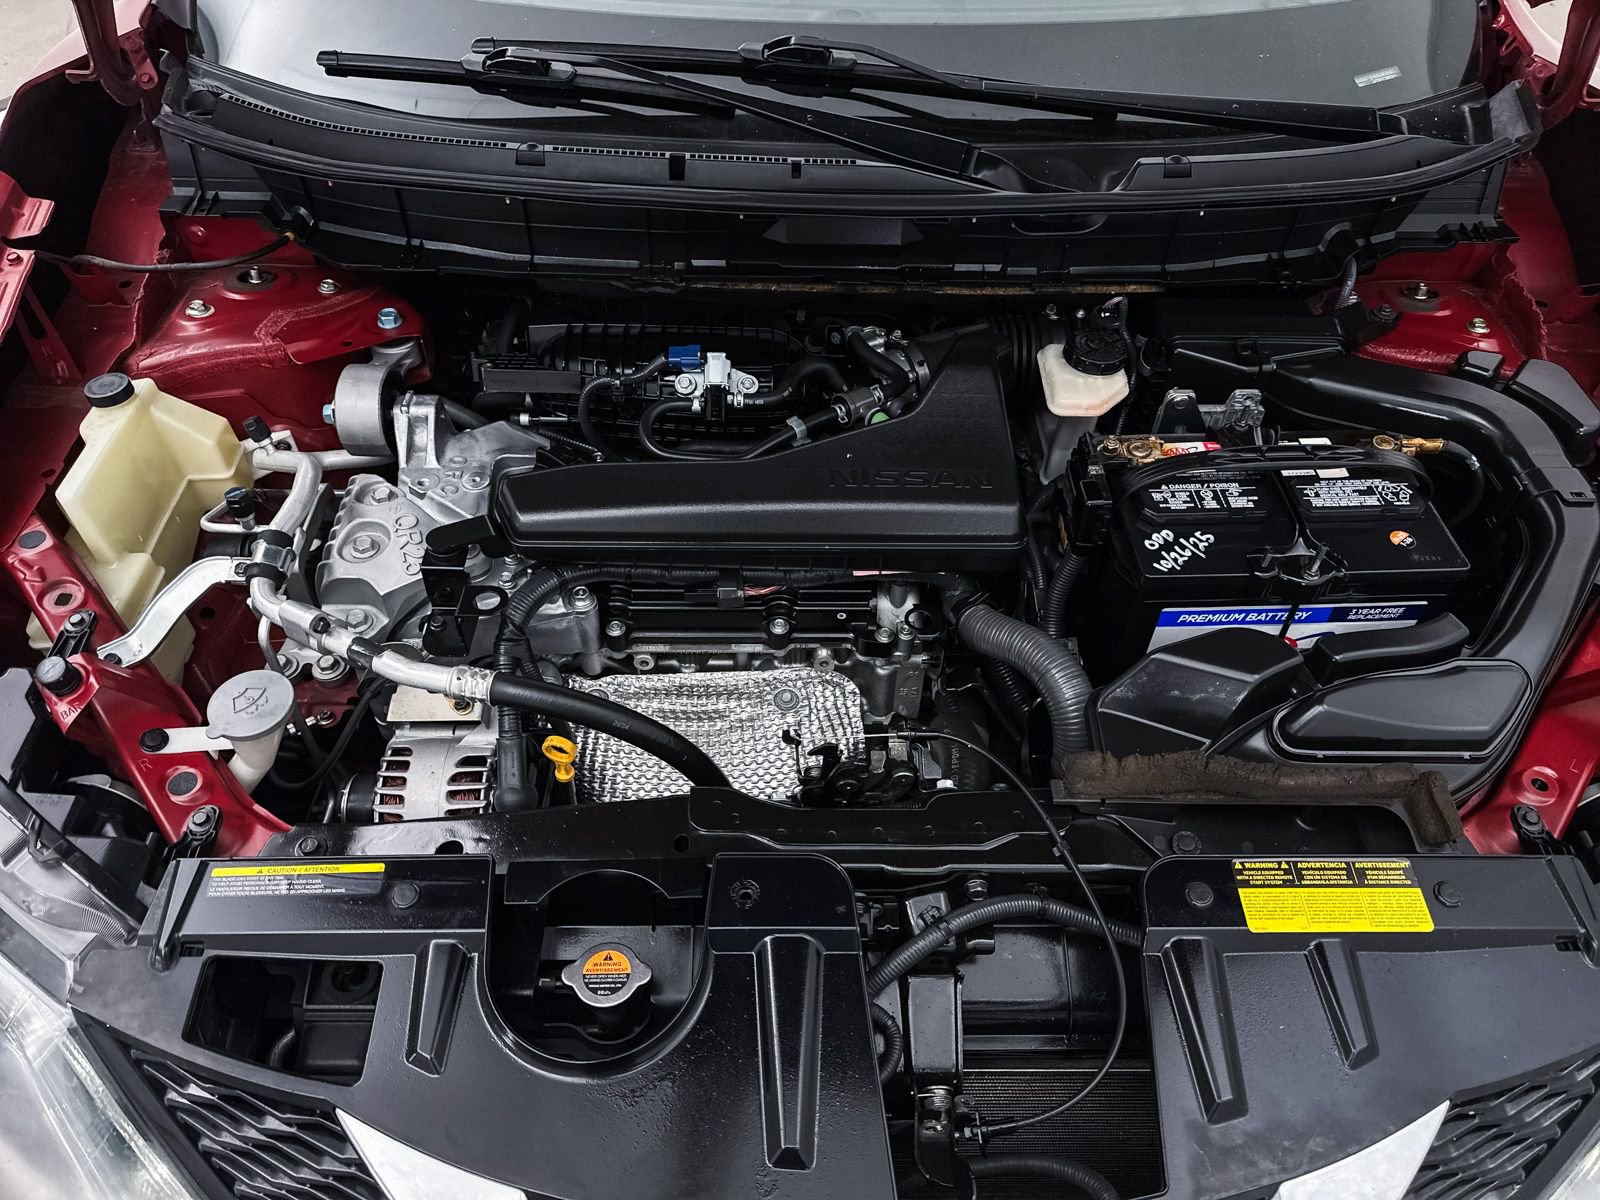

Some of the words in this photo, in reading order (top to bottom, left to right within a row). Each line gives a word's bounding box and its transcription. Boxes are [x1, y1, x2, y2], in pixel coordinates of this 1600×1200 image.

[828, 469, 993, 489] NISSAN
[394, 512, 426, 576] QR25
[1177, 613, 1244, 623] PREMIUM
[1246, 611, 1312, 621] BATTERY
